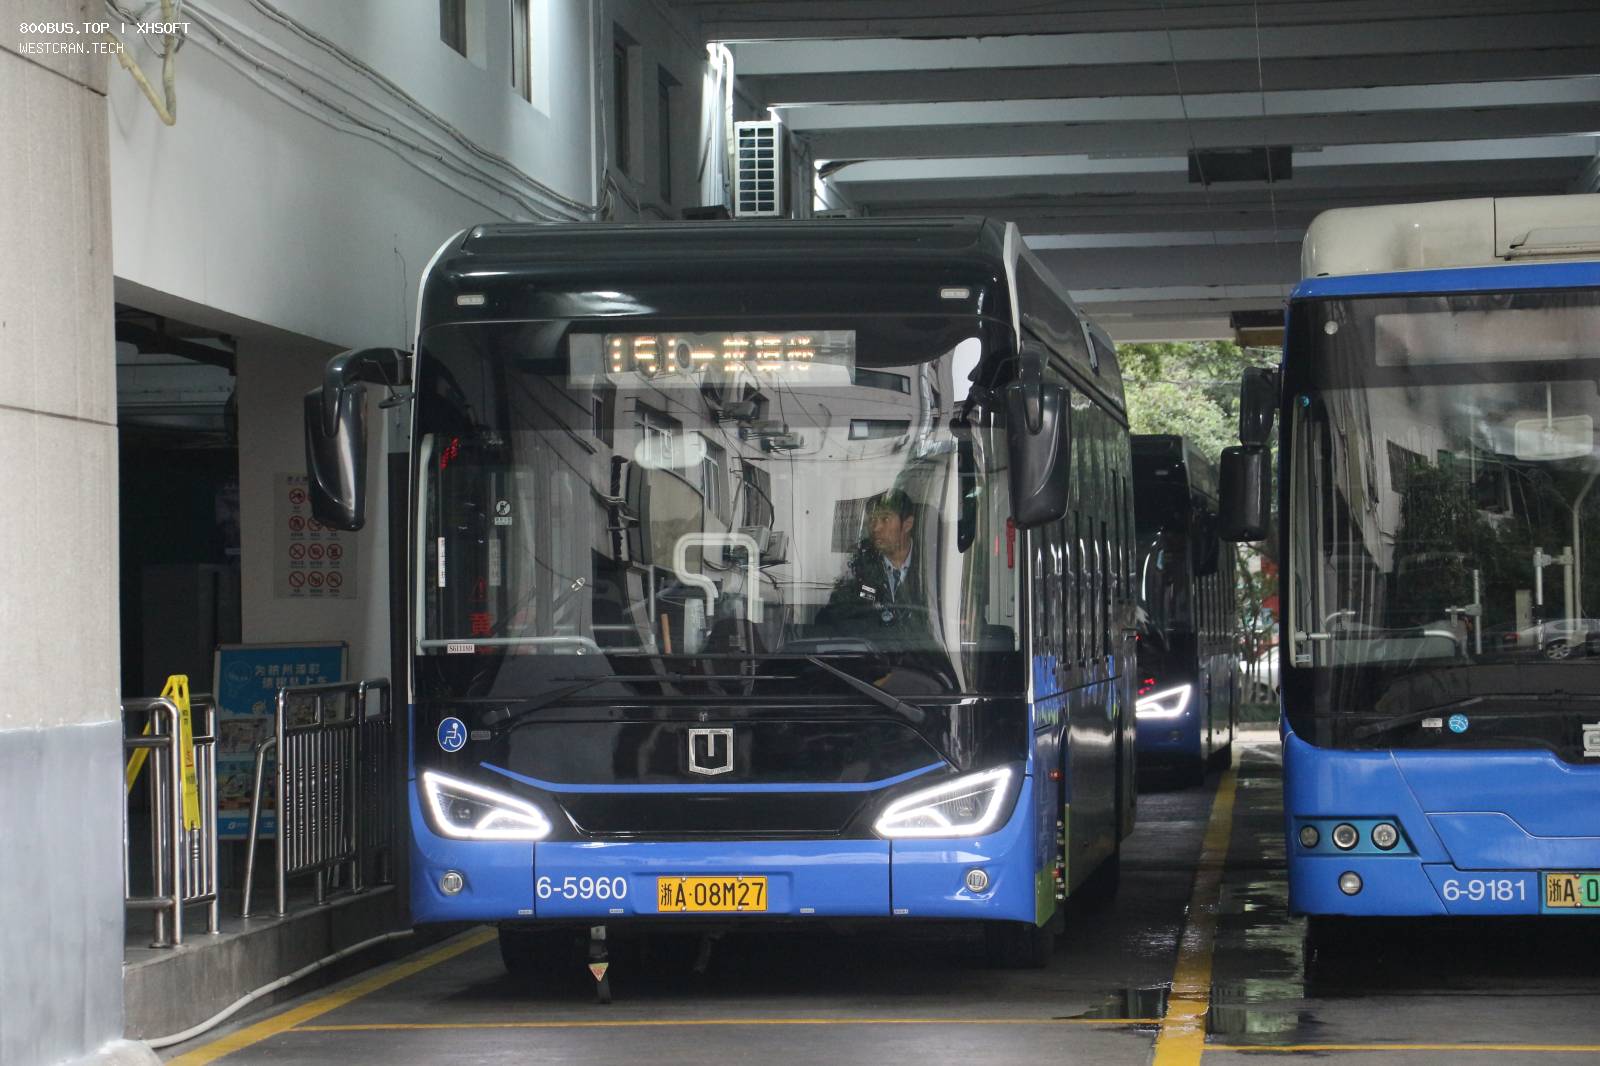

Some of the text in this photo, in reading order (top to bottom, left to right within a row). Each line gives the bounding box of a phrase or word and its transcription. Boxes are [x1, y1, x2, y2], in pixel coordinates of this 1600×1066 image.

[536, 876, 628, 900] 6-5960
[660, 882, 764, 906] 浙A·08M27
[1442, 879, 1526, 901] 6-9181
